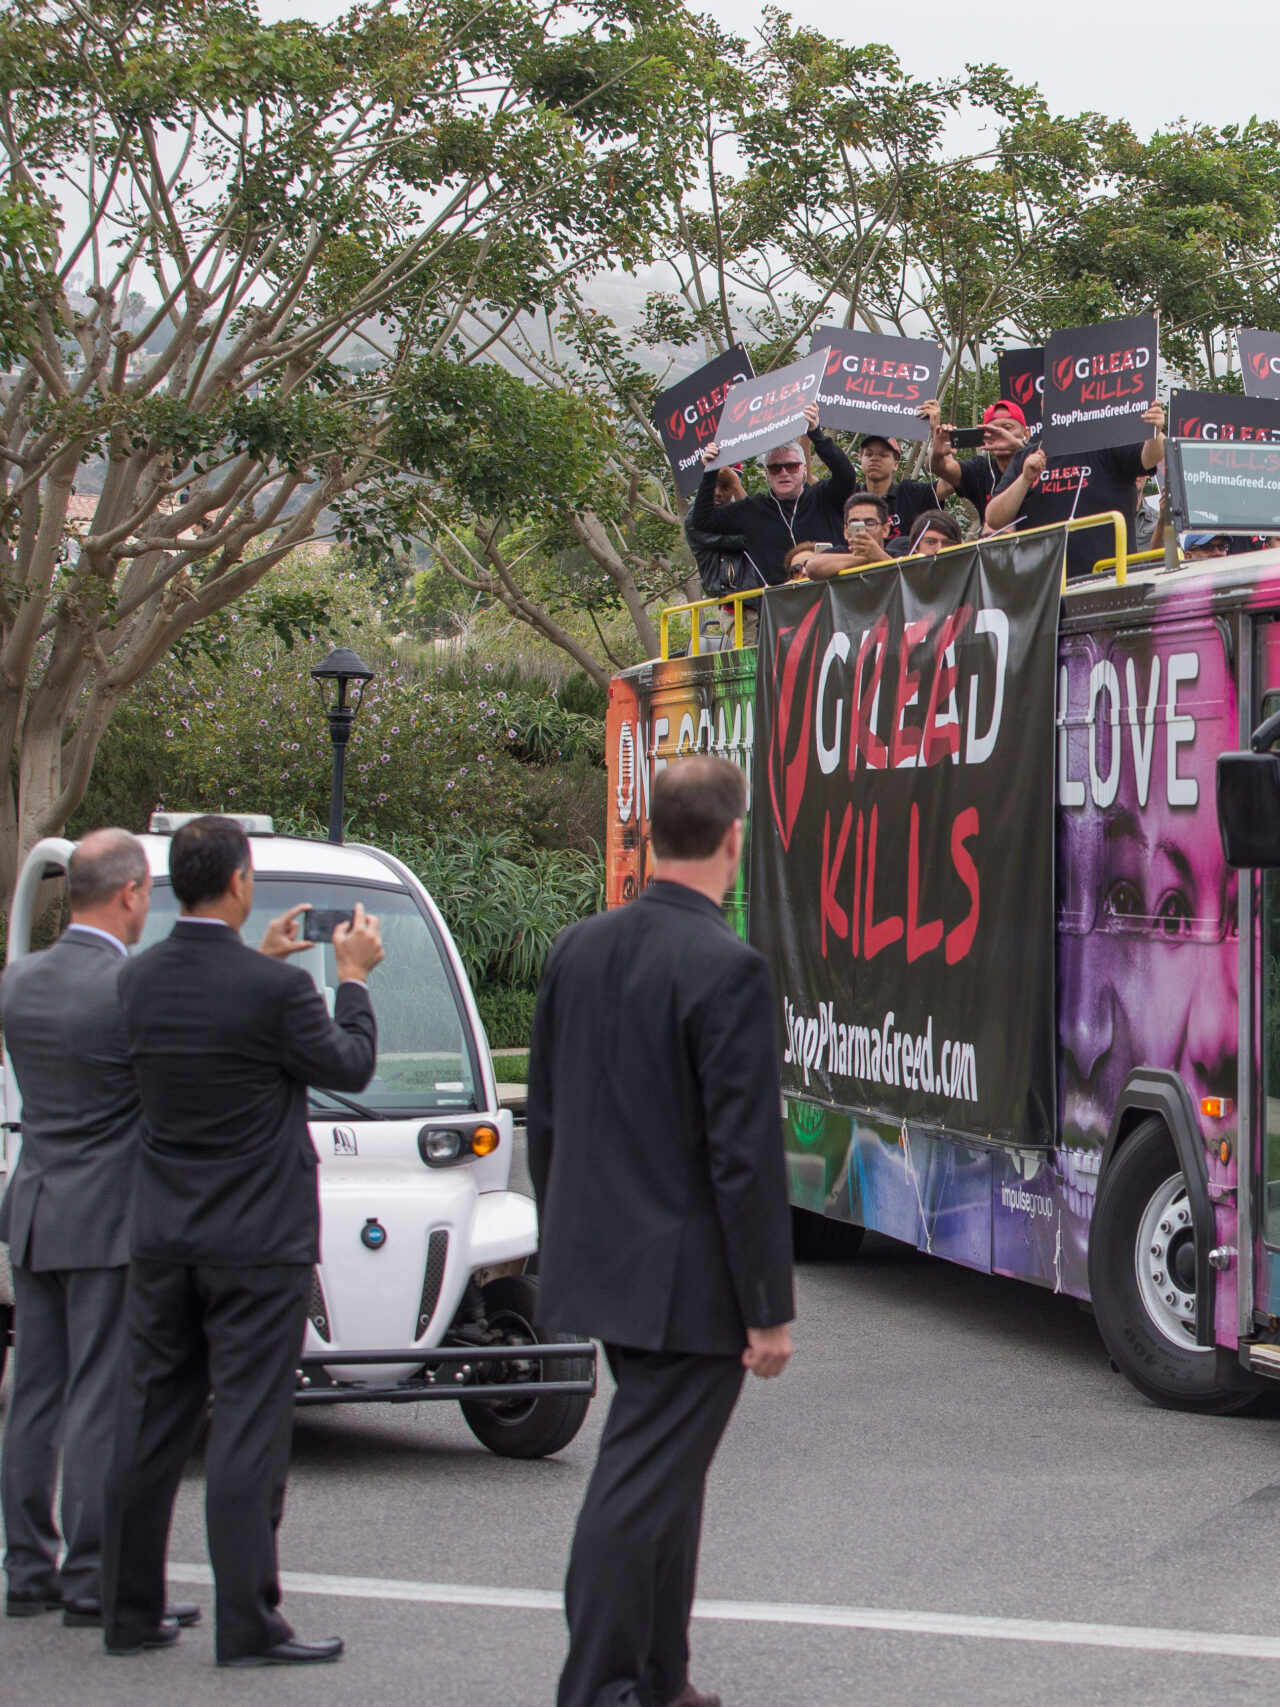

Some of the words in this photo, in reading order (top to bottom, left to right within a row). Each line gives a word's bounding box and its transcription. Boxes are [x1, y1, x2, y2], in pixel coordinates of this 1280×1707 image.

[845, 375, 920, 400] KILLS
[1081, 373, 1145, 404] KILLS
[748, 394, 806, 428] KILLS
[816, 391, 924, 417] topPharmaGreed.com
[1051, 400, 1149, 427] StopPharmaGreed.com
[1208, 447, 1280, 472] KILLS
[1041, 477, 1089, 494] KILLS
[1058, 652, 1199, 808] LOVE
[820, 801, 981, 966] KILLS
[784, 995, 979, 1102] StopPharmaGreed.com
[1002, 1180, 1053, 1222] impulsegroup
